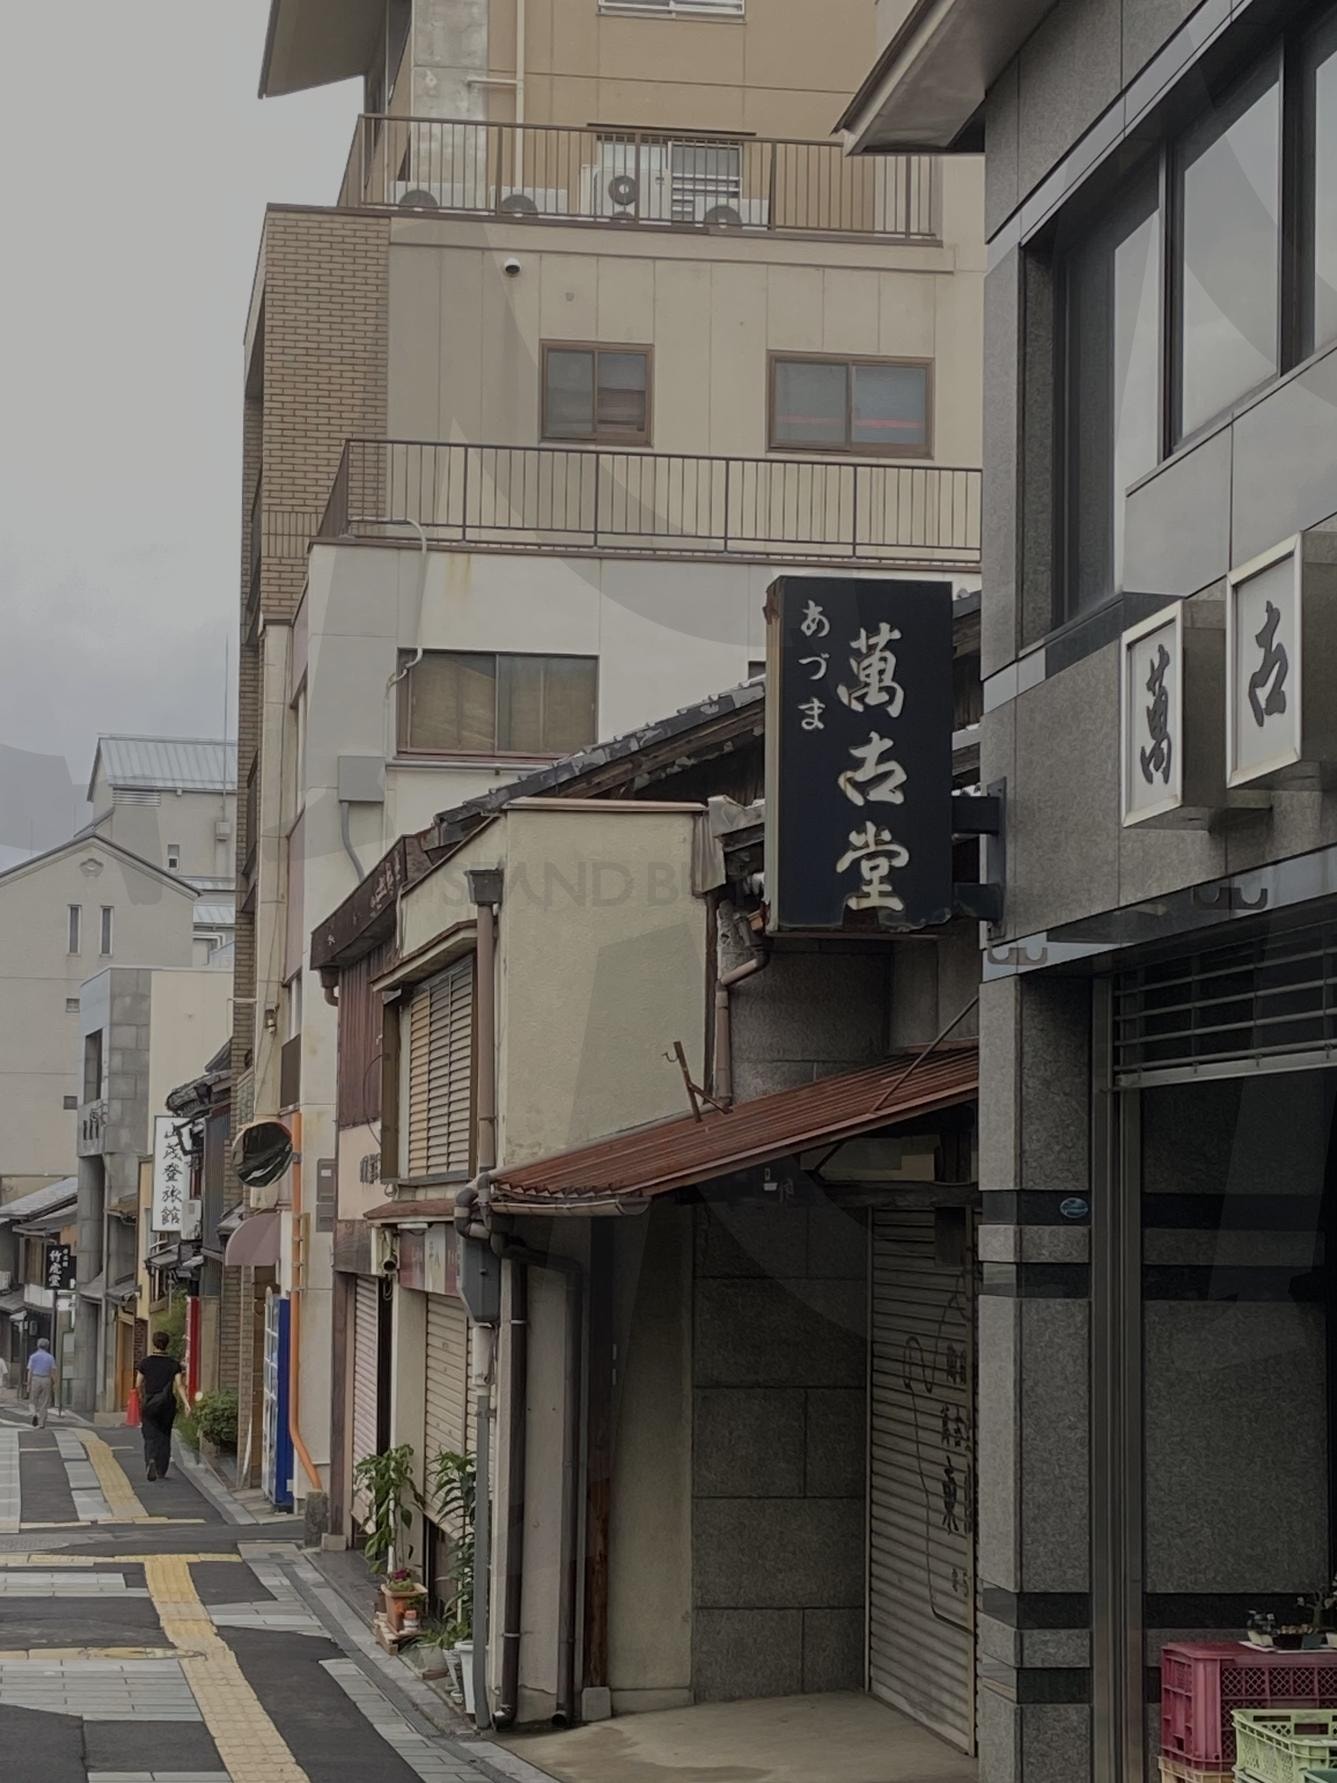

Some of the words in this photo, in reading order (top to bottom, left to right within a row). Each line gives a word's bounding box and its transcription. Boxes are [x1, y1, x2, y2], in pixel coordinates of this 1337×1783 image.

[797, 599, 832, 732] あづま
[1140, 643, 1173, 786] 萬
[1248, 600, 1289, 728] 古
[836, 621, 909, 912] 萬古堂
